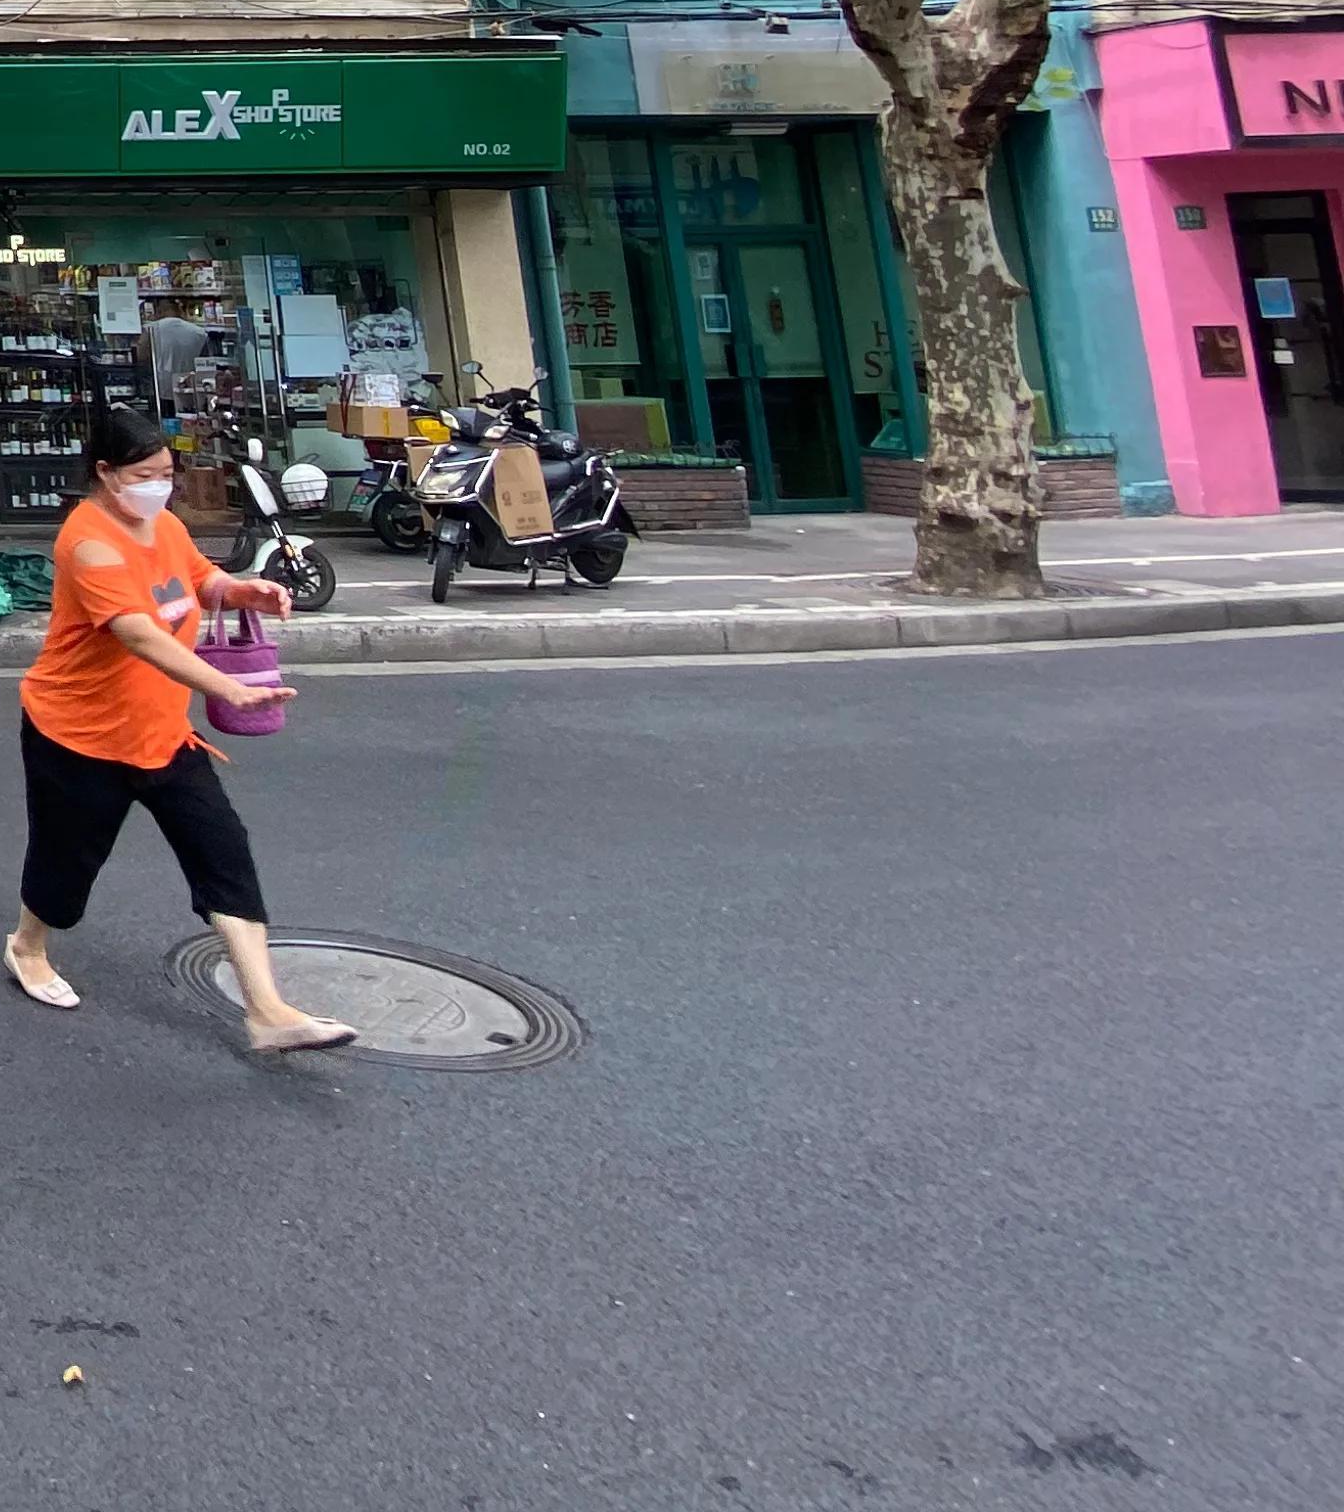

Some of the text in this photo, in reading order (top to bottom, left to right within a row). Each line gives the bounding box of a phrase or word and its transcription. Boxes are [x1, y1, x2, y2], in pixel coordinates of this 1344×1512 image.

[121, 90, 241, 141] ALEX
[279, 104, 341, 127] STORE
[463, 143, 511, 156] NO.02
[16, 248, 66, 267] STORE
[564, 322, 617, 348] 商店
